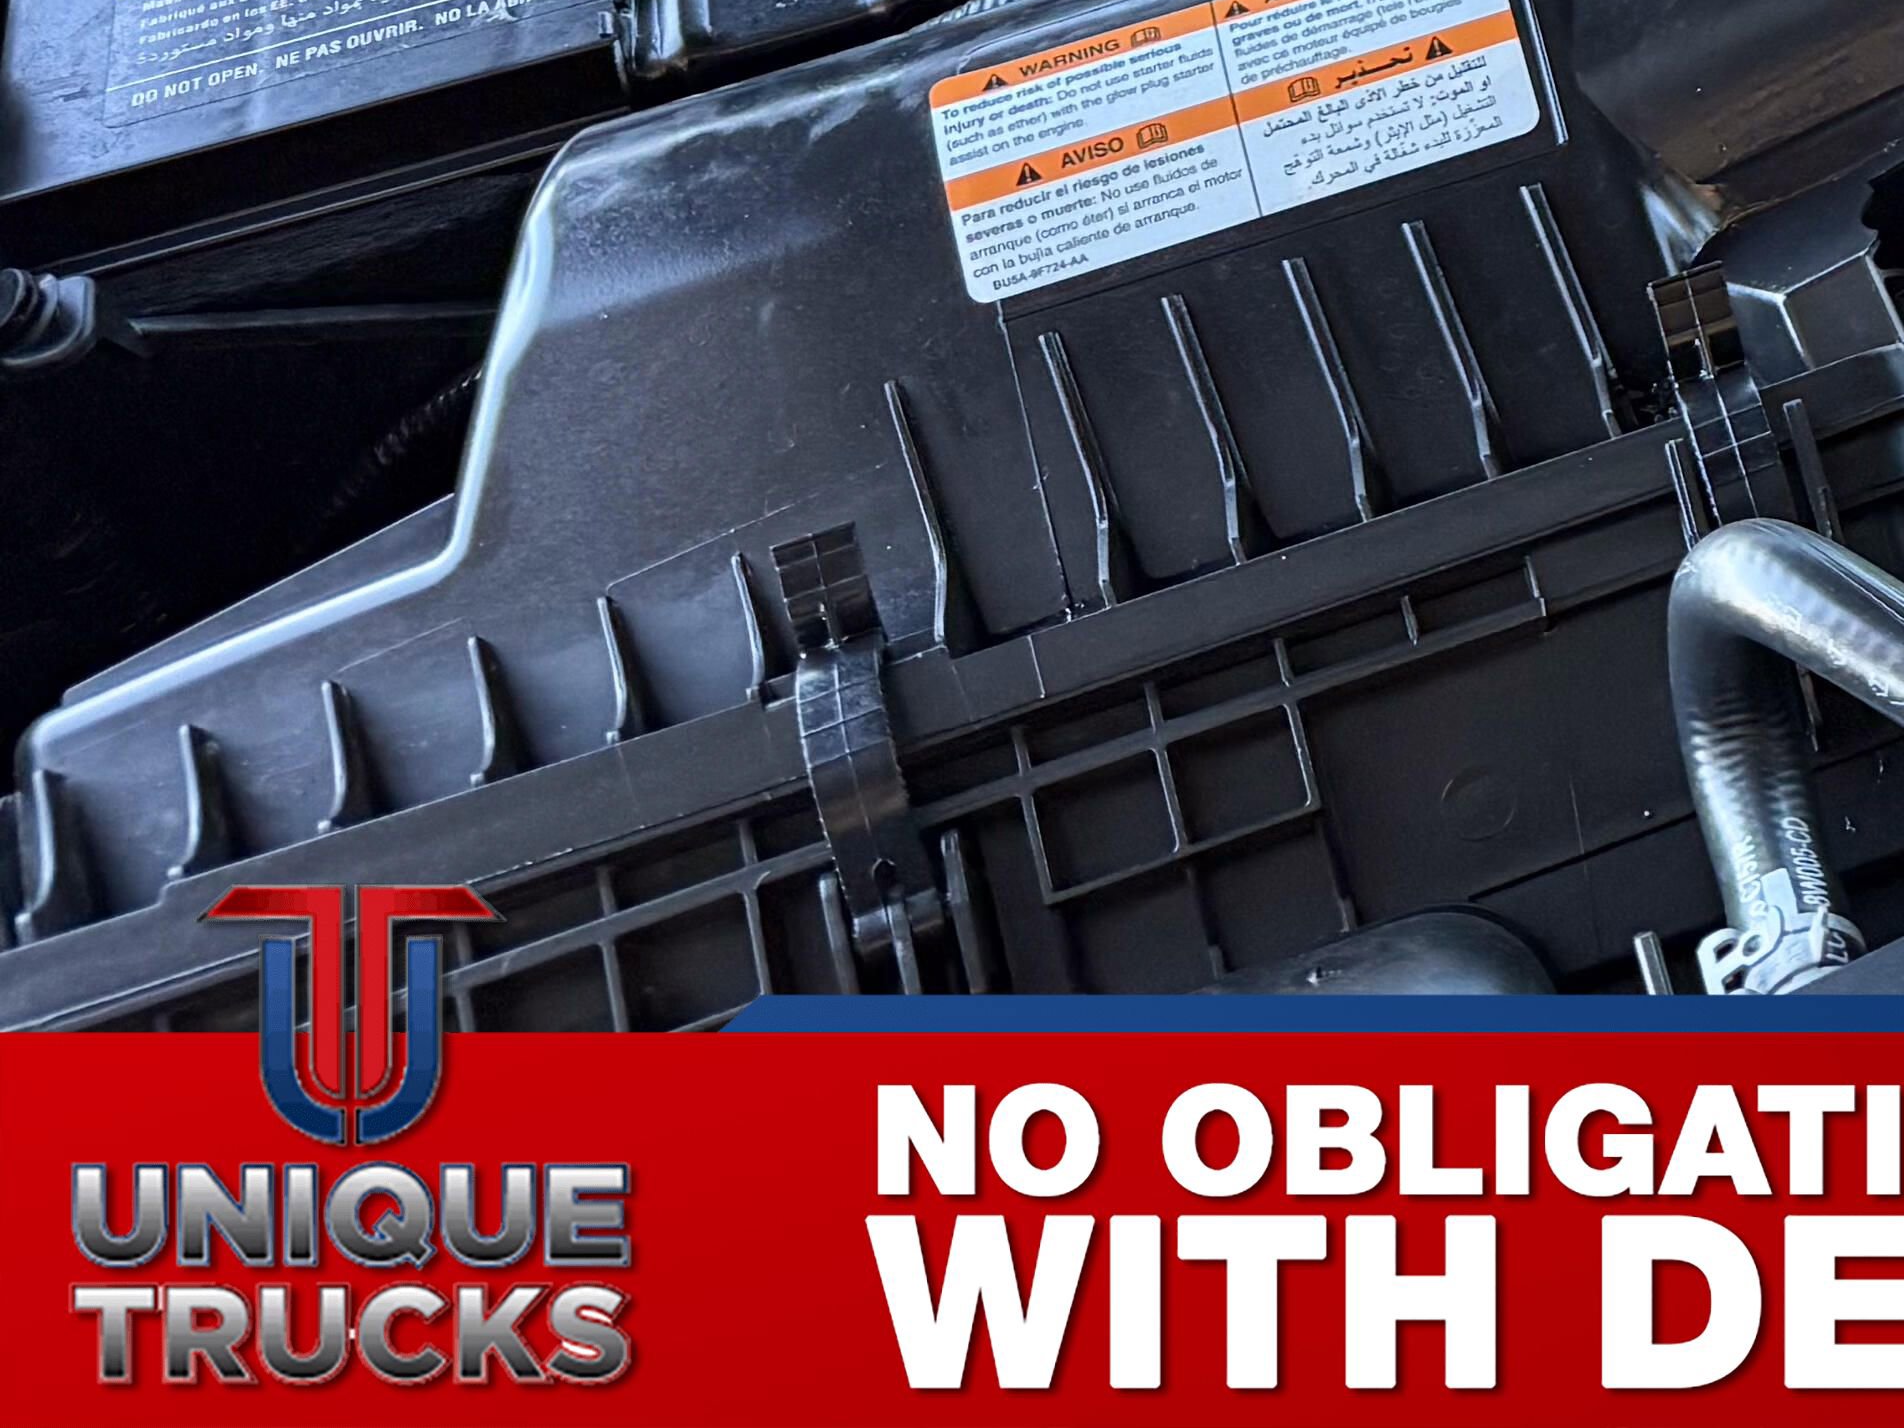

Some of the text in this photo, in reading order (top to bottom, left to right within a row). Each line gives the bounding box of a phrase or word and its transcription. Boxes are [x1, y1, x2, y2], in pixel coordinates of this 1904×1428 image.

[131, 89, 159, 110] DO
[162, 76, 205, 98] NOT
[273, 50, 302, 69] NE
[302, 40, 342, 61] PAS
[344, 17, 424, 50] OUVRIR.
[433, 8, 462, 26] NO
[464, 0, 490, 17] LA
[941, 40, 1182, 120] To reduce risk of possible serious
[1018, 37, 1121, 78] WARNING
[942, 114, 986, 137] injury
[987, 109, 1004, 121] or
[1014, 93, 1054, 114] death:
[1056, 85, 1082, 101] Do
[1086, 79, 1102, 92] not
[1104, 71, 1129, 86] use
[1132, 58, 1175, 78] starter
[945, 61, 1215, 151] (such as ether) with the glow plug starter
[948, 144, 989, 166] assist
[990, 139, 1010, 153] on
[1012, 130, 1035, 147] the
[960, 141, 1205, 226] Para reducir el riesgo de lesiones
[1058, 135, 1125, 169] AVISO
[964, 156, 1219, 244] severas o muerte: No use fluidos de
